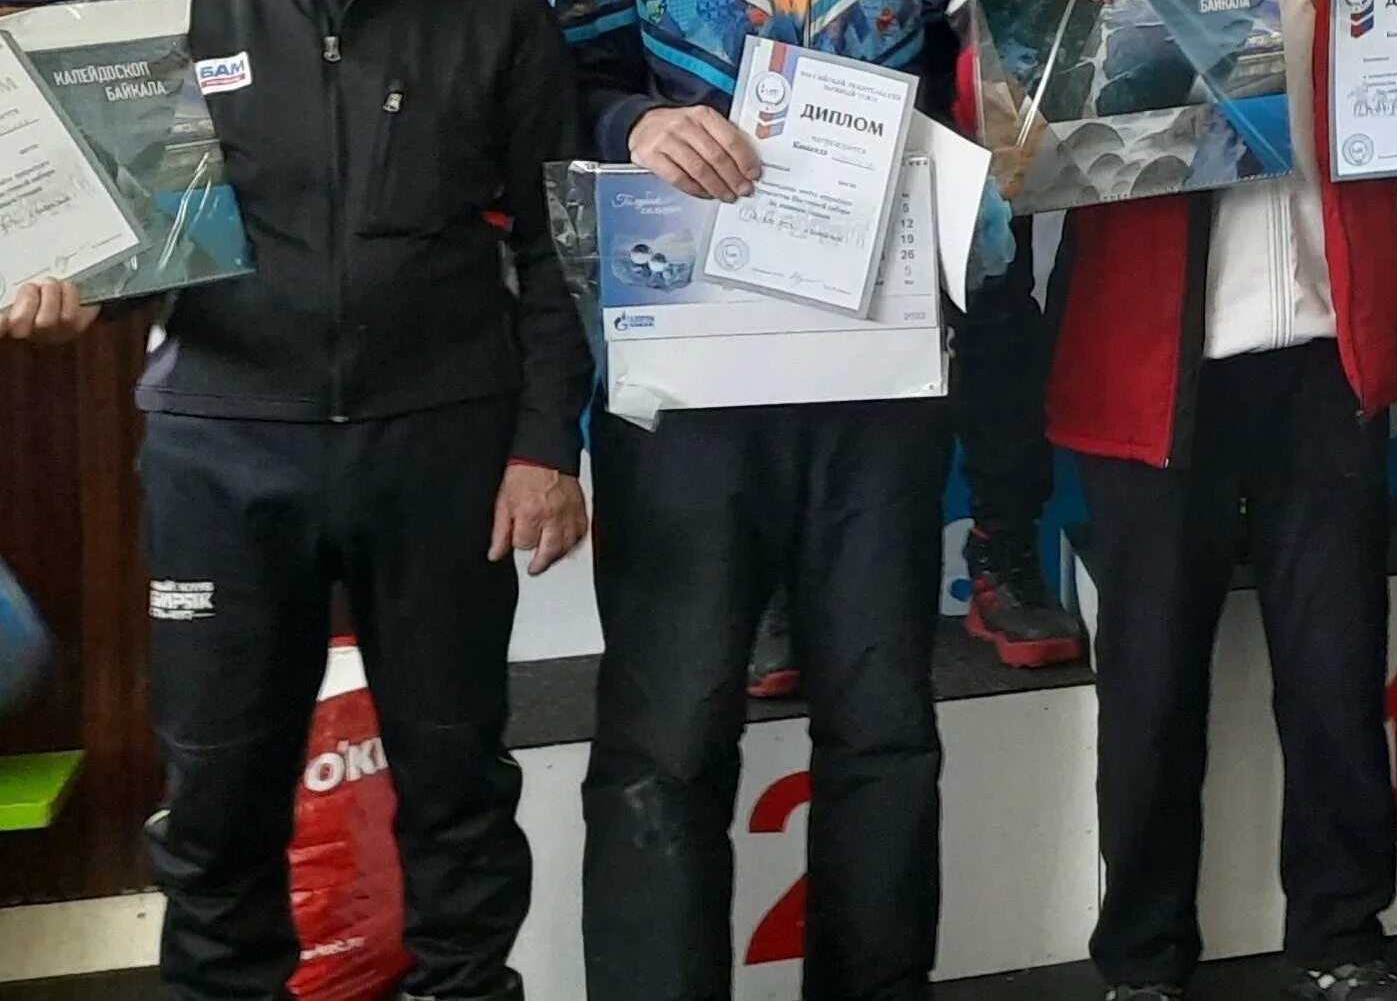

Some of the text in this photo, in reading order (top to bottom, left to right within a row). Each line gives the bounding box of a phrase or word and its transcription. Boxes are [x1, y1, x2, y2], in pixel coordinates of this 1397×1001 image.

[54, 60, 151, 87] КАЛЕЙДОСКОП
[201, 60, 245, 78] БАМ
[105, 80, 167, 102] БАЙКАЛА
[800, 102, 885, 138] ДИПЛОМ
[902, 202, 910, 213] 5
[900, 219, 914, 229] 12
[900, 235, 914, 244] 19
